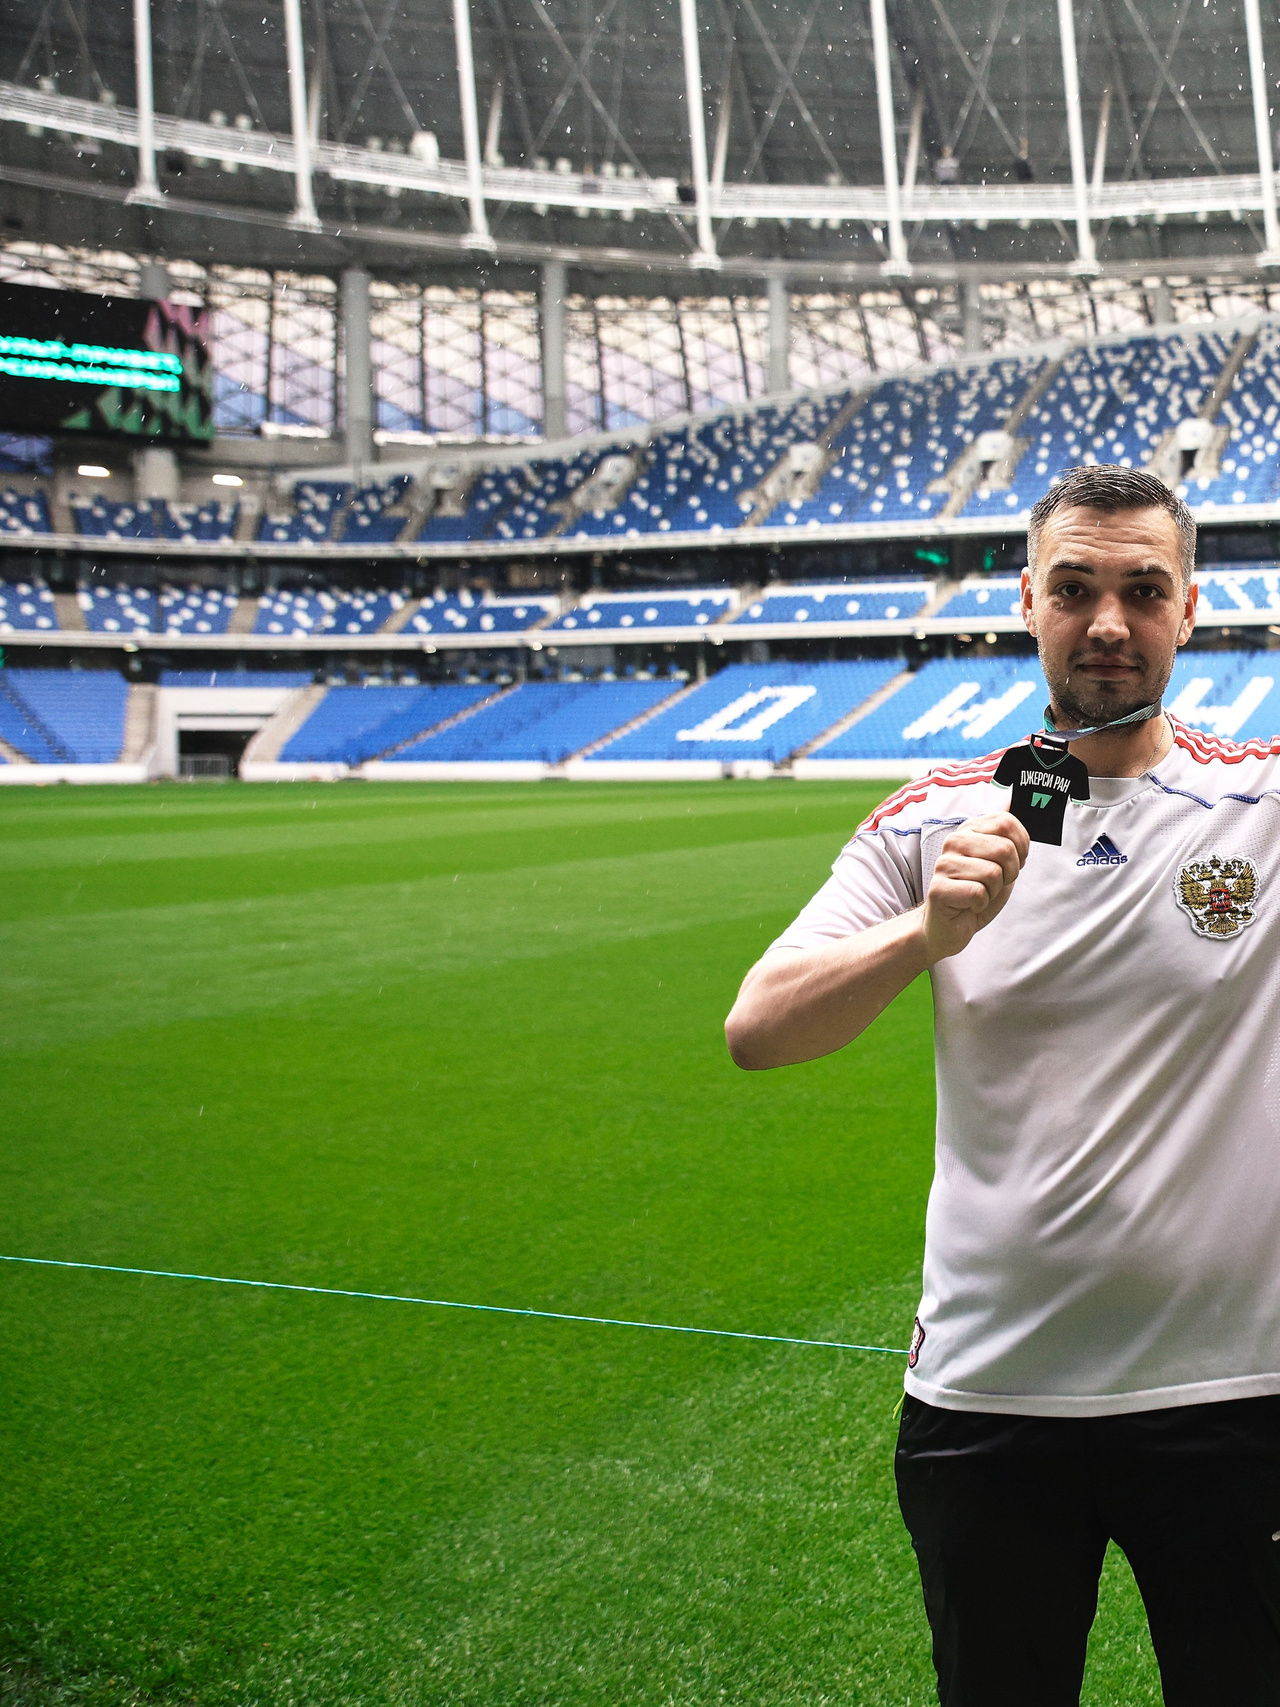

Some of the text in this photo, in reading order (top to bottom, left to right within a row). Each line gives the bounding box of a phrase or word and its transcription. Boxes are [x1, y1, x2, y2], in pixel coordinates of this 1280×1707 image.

[1020, 770, 1071, 793] ДЖЕРСИ РАН
[1076, 855, 1128, 867] adidas
